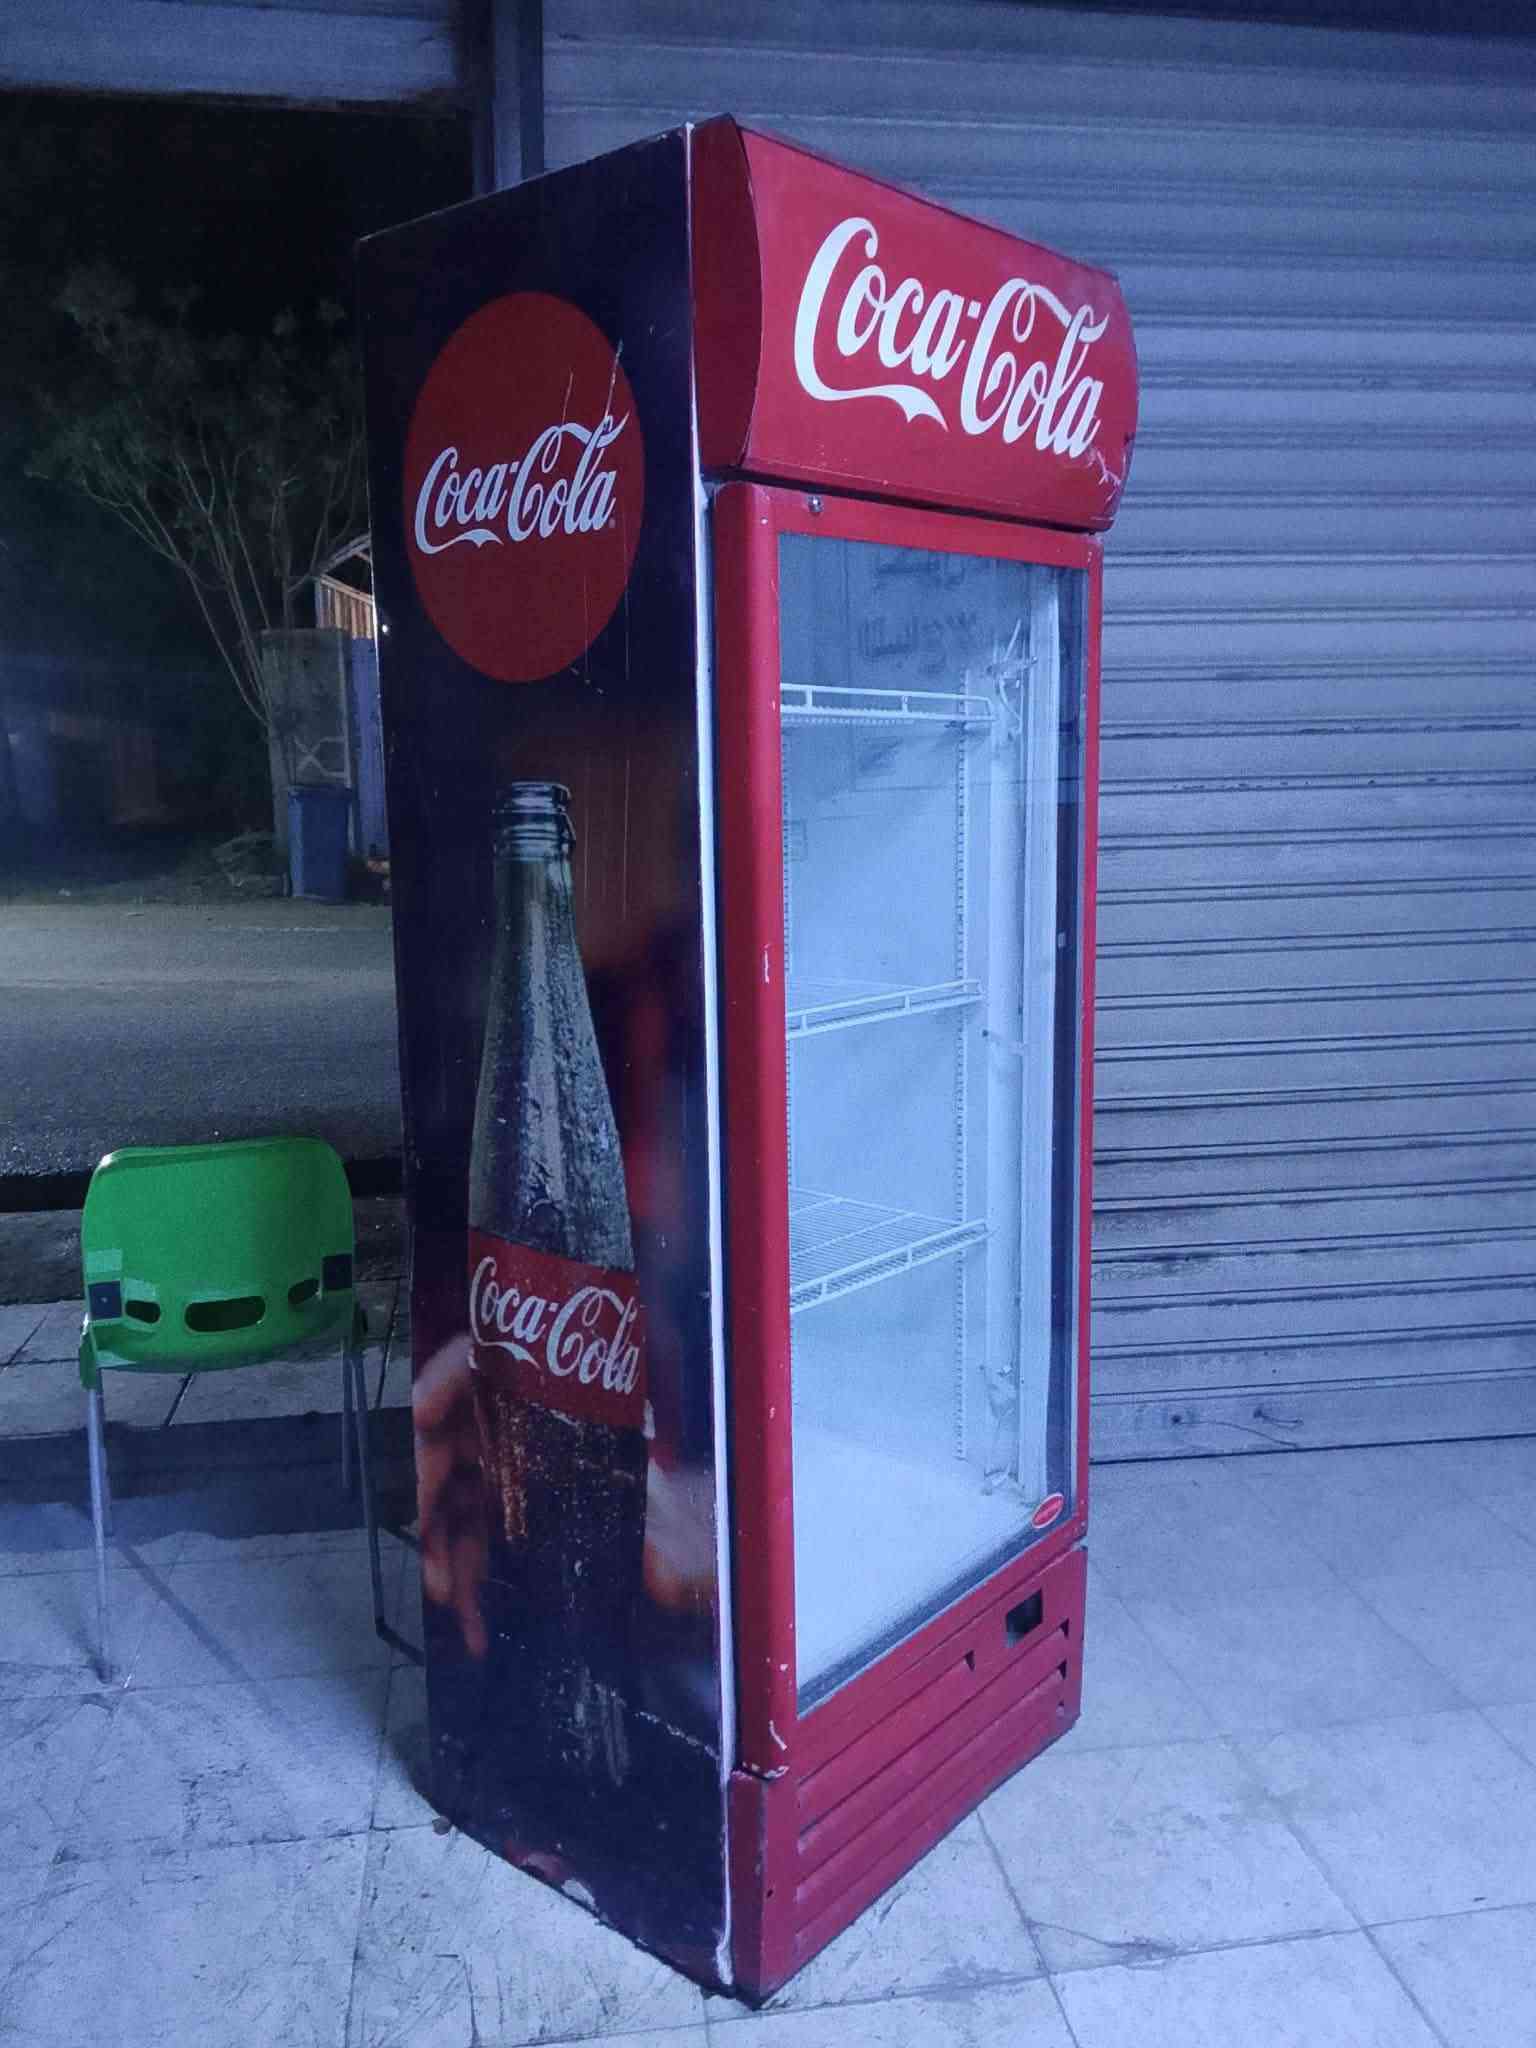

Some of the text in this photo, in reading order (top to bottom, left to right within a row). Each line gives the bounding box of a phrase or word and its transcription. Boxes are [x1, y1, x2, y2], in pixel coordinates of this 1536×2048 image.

[794, 217, 1109, 458] Coca-Cola
[414, 411, 629, 555] Coca-Cola
[470, 1255, 640, 1394] Coca-Cola
